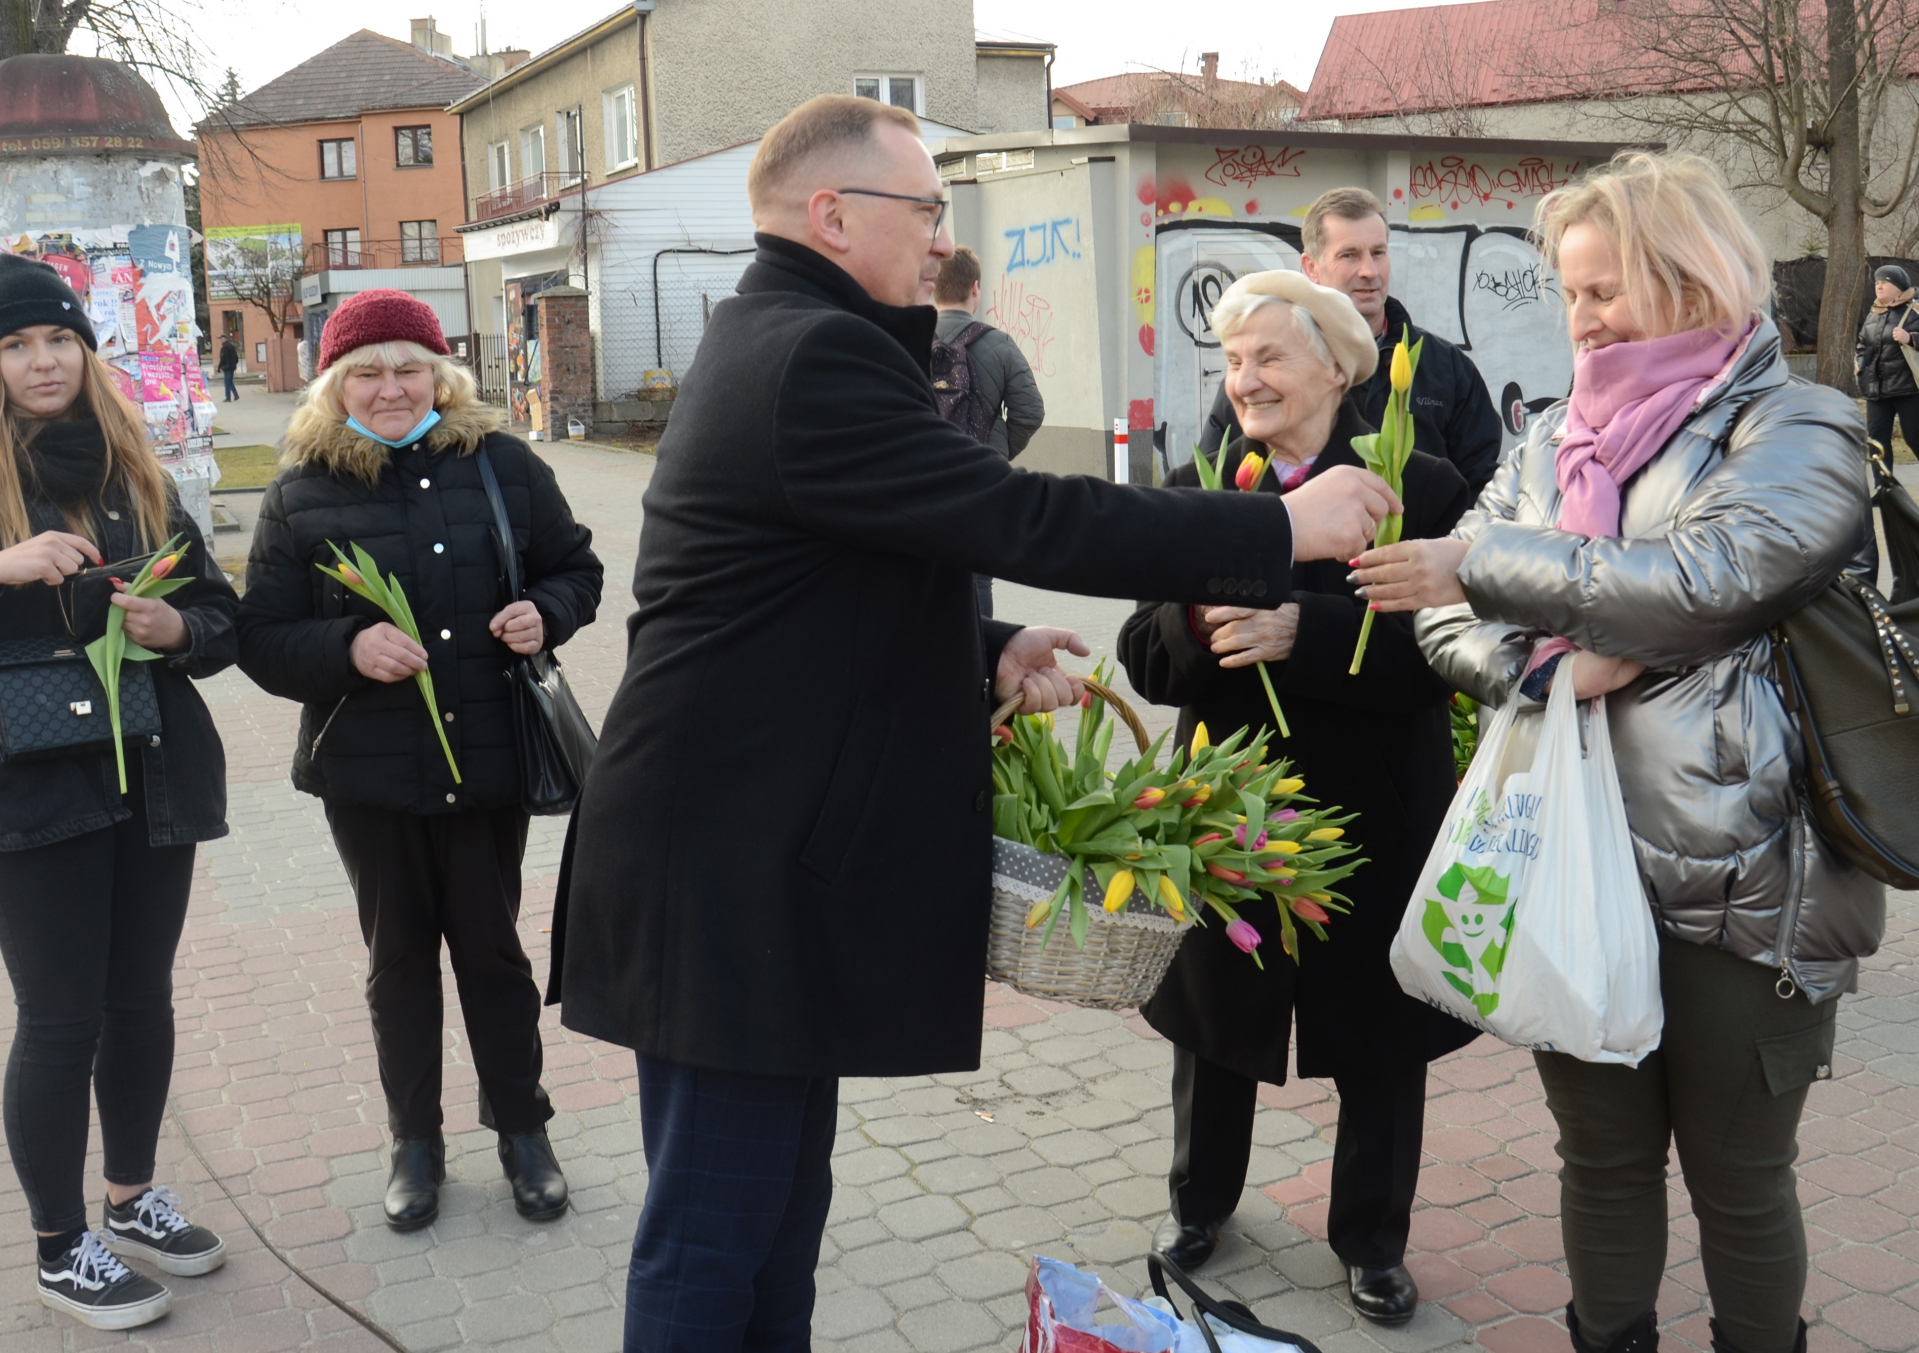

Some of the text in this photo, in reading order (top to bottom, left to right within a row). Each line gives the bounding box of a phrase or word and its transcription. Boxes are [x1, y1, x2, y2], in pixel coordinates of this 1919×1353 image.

[104, 136, 123, 148] 28
[127, 137, 144, 149] 22
[148, 260, 173, 271] Nowym
